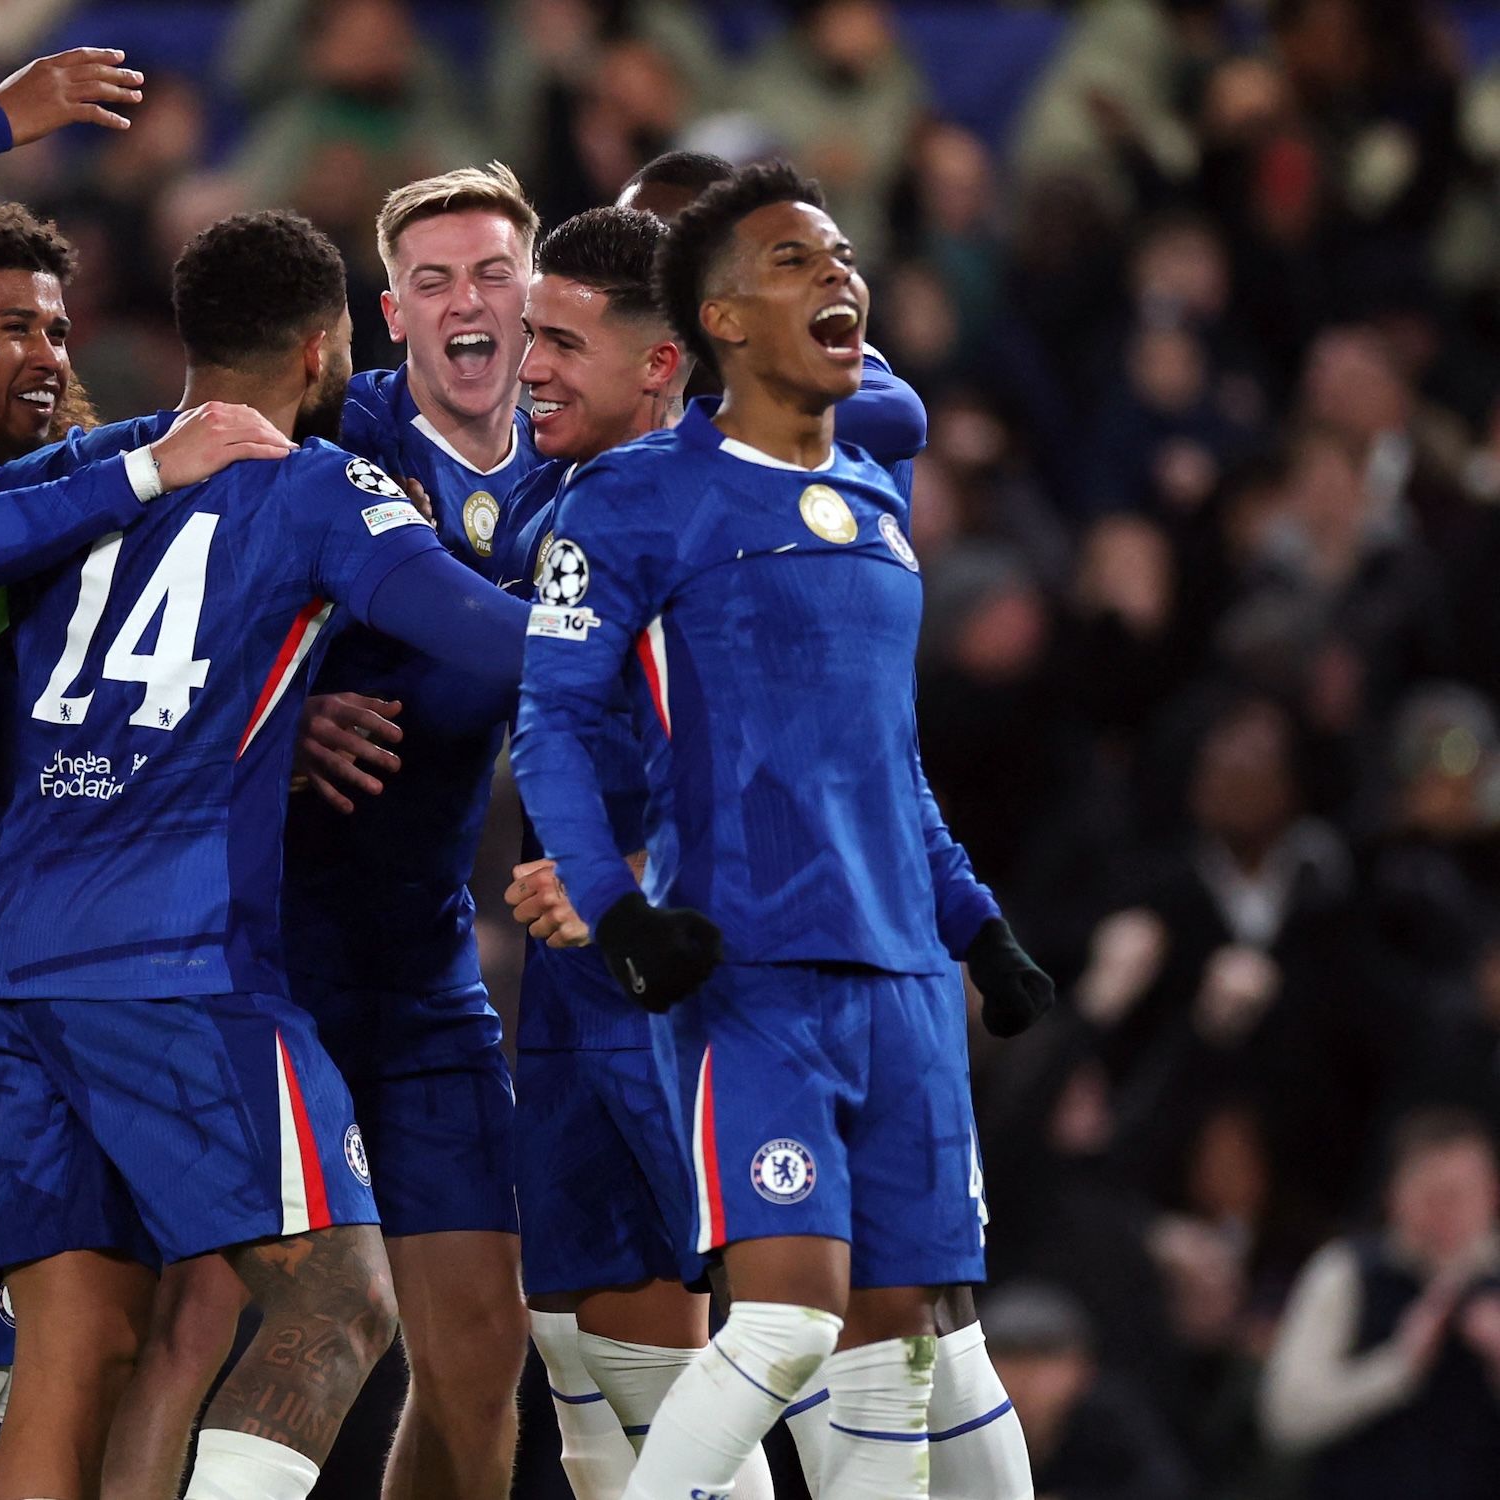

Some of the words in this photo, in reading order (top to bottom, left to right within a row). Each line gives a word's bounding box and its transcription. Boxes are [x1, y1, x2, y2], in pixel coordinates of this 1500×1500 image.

[367, 509, 416, 526] FOUNDAT
[476, 540, 492, 552] FIFA
[31, 511, 220, 731] 14
